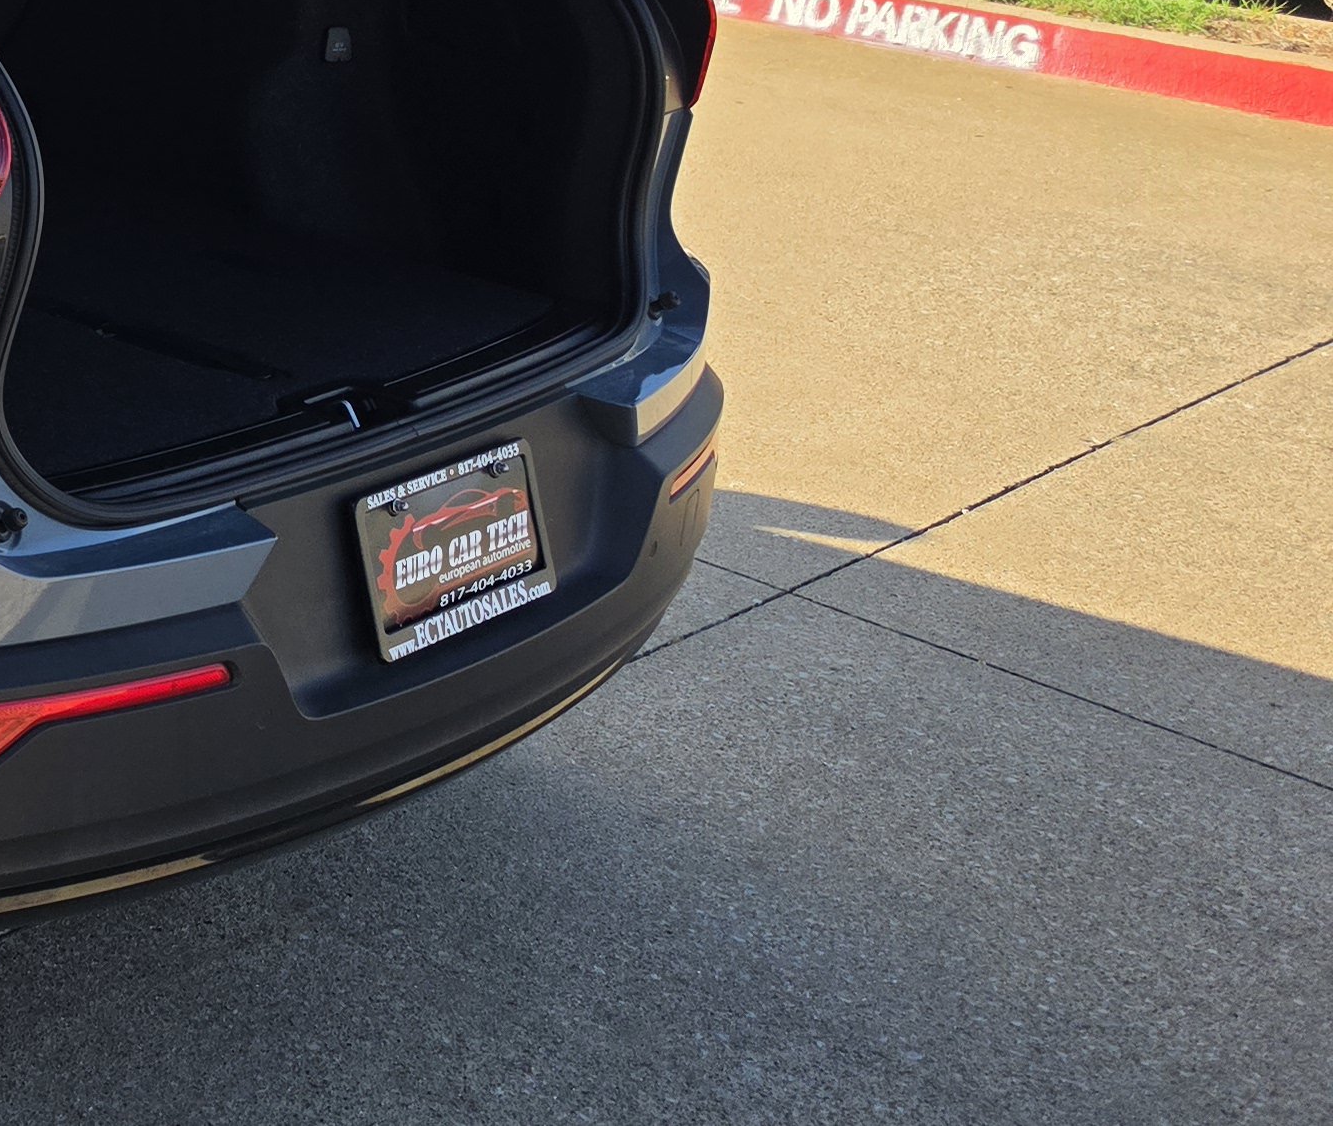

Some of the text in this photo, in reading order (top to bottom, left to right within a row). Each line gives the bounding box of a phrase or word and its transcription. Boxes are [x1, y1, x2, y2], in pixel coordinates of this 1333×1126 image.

[366, 443, 520, 510] SALES & SERVICE 817-404-4033
[395, 510, 529, 590] EURO CAR TECH
[438, 538, 532, 584] european automotive
[440, 559, 533, 608] 817-404-4033
[388, 580, 552, 662] www.ECTAUTOSALES.com
